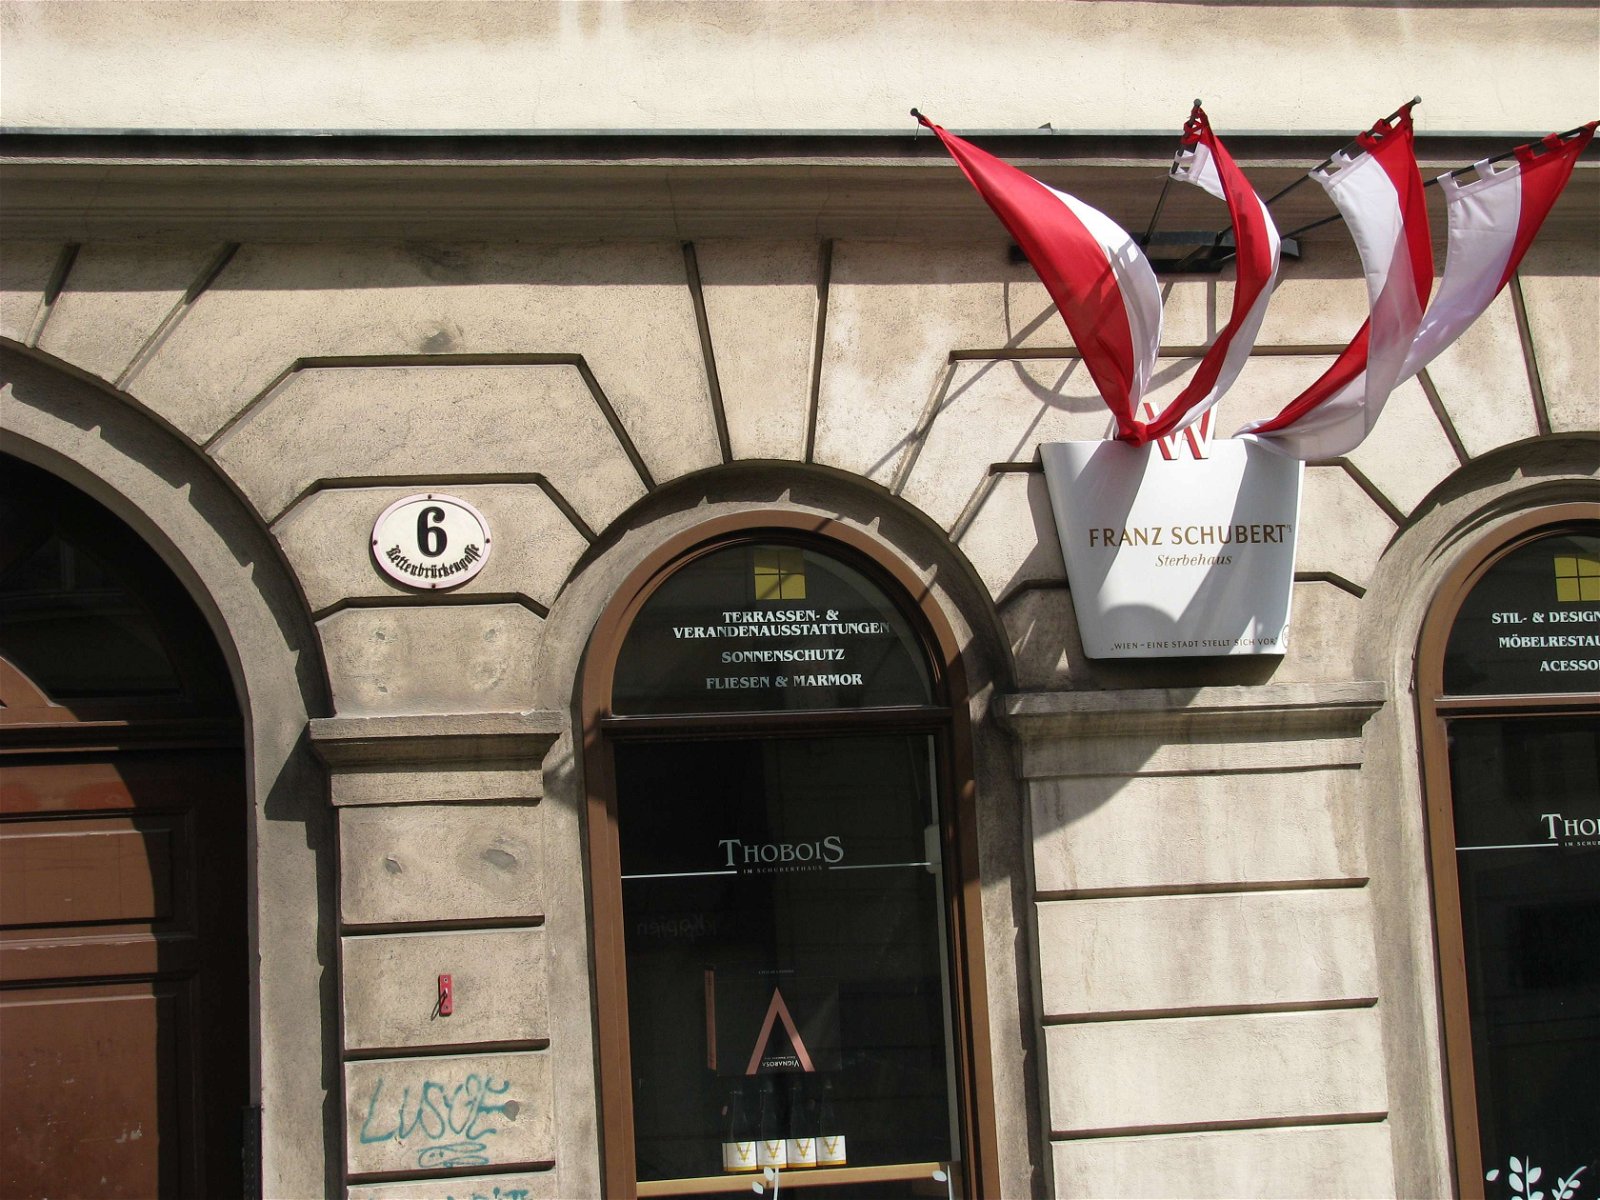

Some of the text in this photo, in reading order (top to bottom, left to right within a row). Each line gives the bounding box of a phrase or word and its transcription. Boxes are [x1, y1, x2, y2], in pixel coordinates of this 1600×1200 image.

[417, 506, 447, 558] 6
[1089, 527, 1163, 547] FRANZ
[1155, 553, 1233, 567] Sterbehaus
[723, 609, 839, 623] TERRASSEN- &
[1491, 612, 1528, 624] STIL-
[1532, 611, 1545, 623] &
[672, 622, 890, 639] VERANDENAUSSTATTUNGEN
[1147, 641, 1168, 649] EINE
[1172, 640, 1199, 648] STADT
[1202, 639, 1231, 647] STELLT
[1234, 638, 1254, 646] SICH
[721, 649, 845, 663] SONNENSCHUTZ
[1540, 660, 1600, 672] ACESSO
[706, 673, 863, 689] FLIESEN & MARMOR
[1540, 813, 1600, 840] THO
